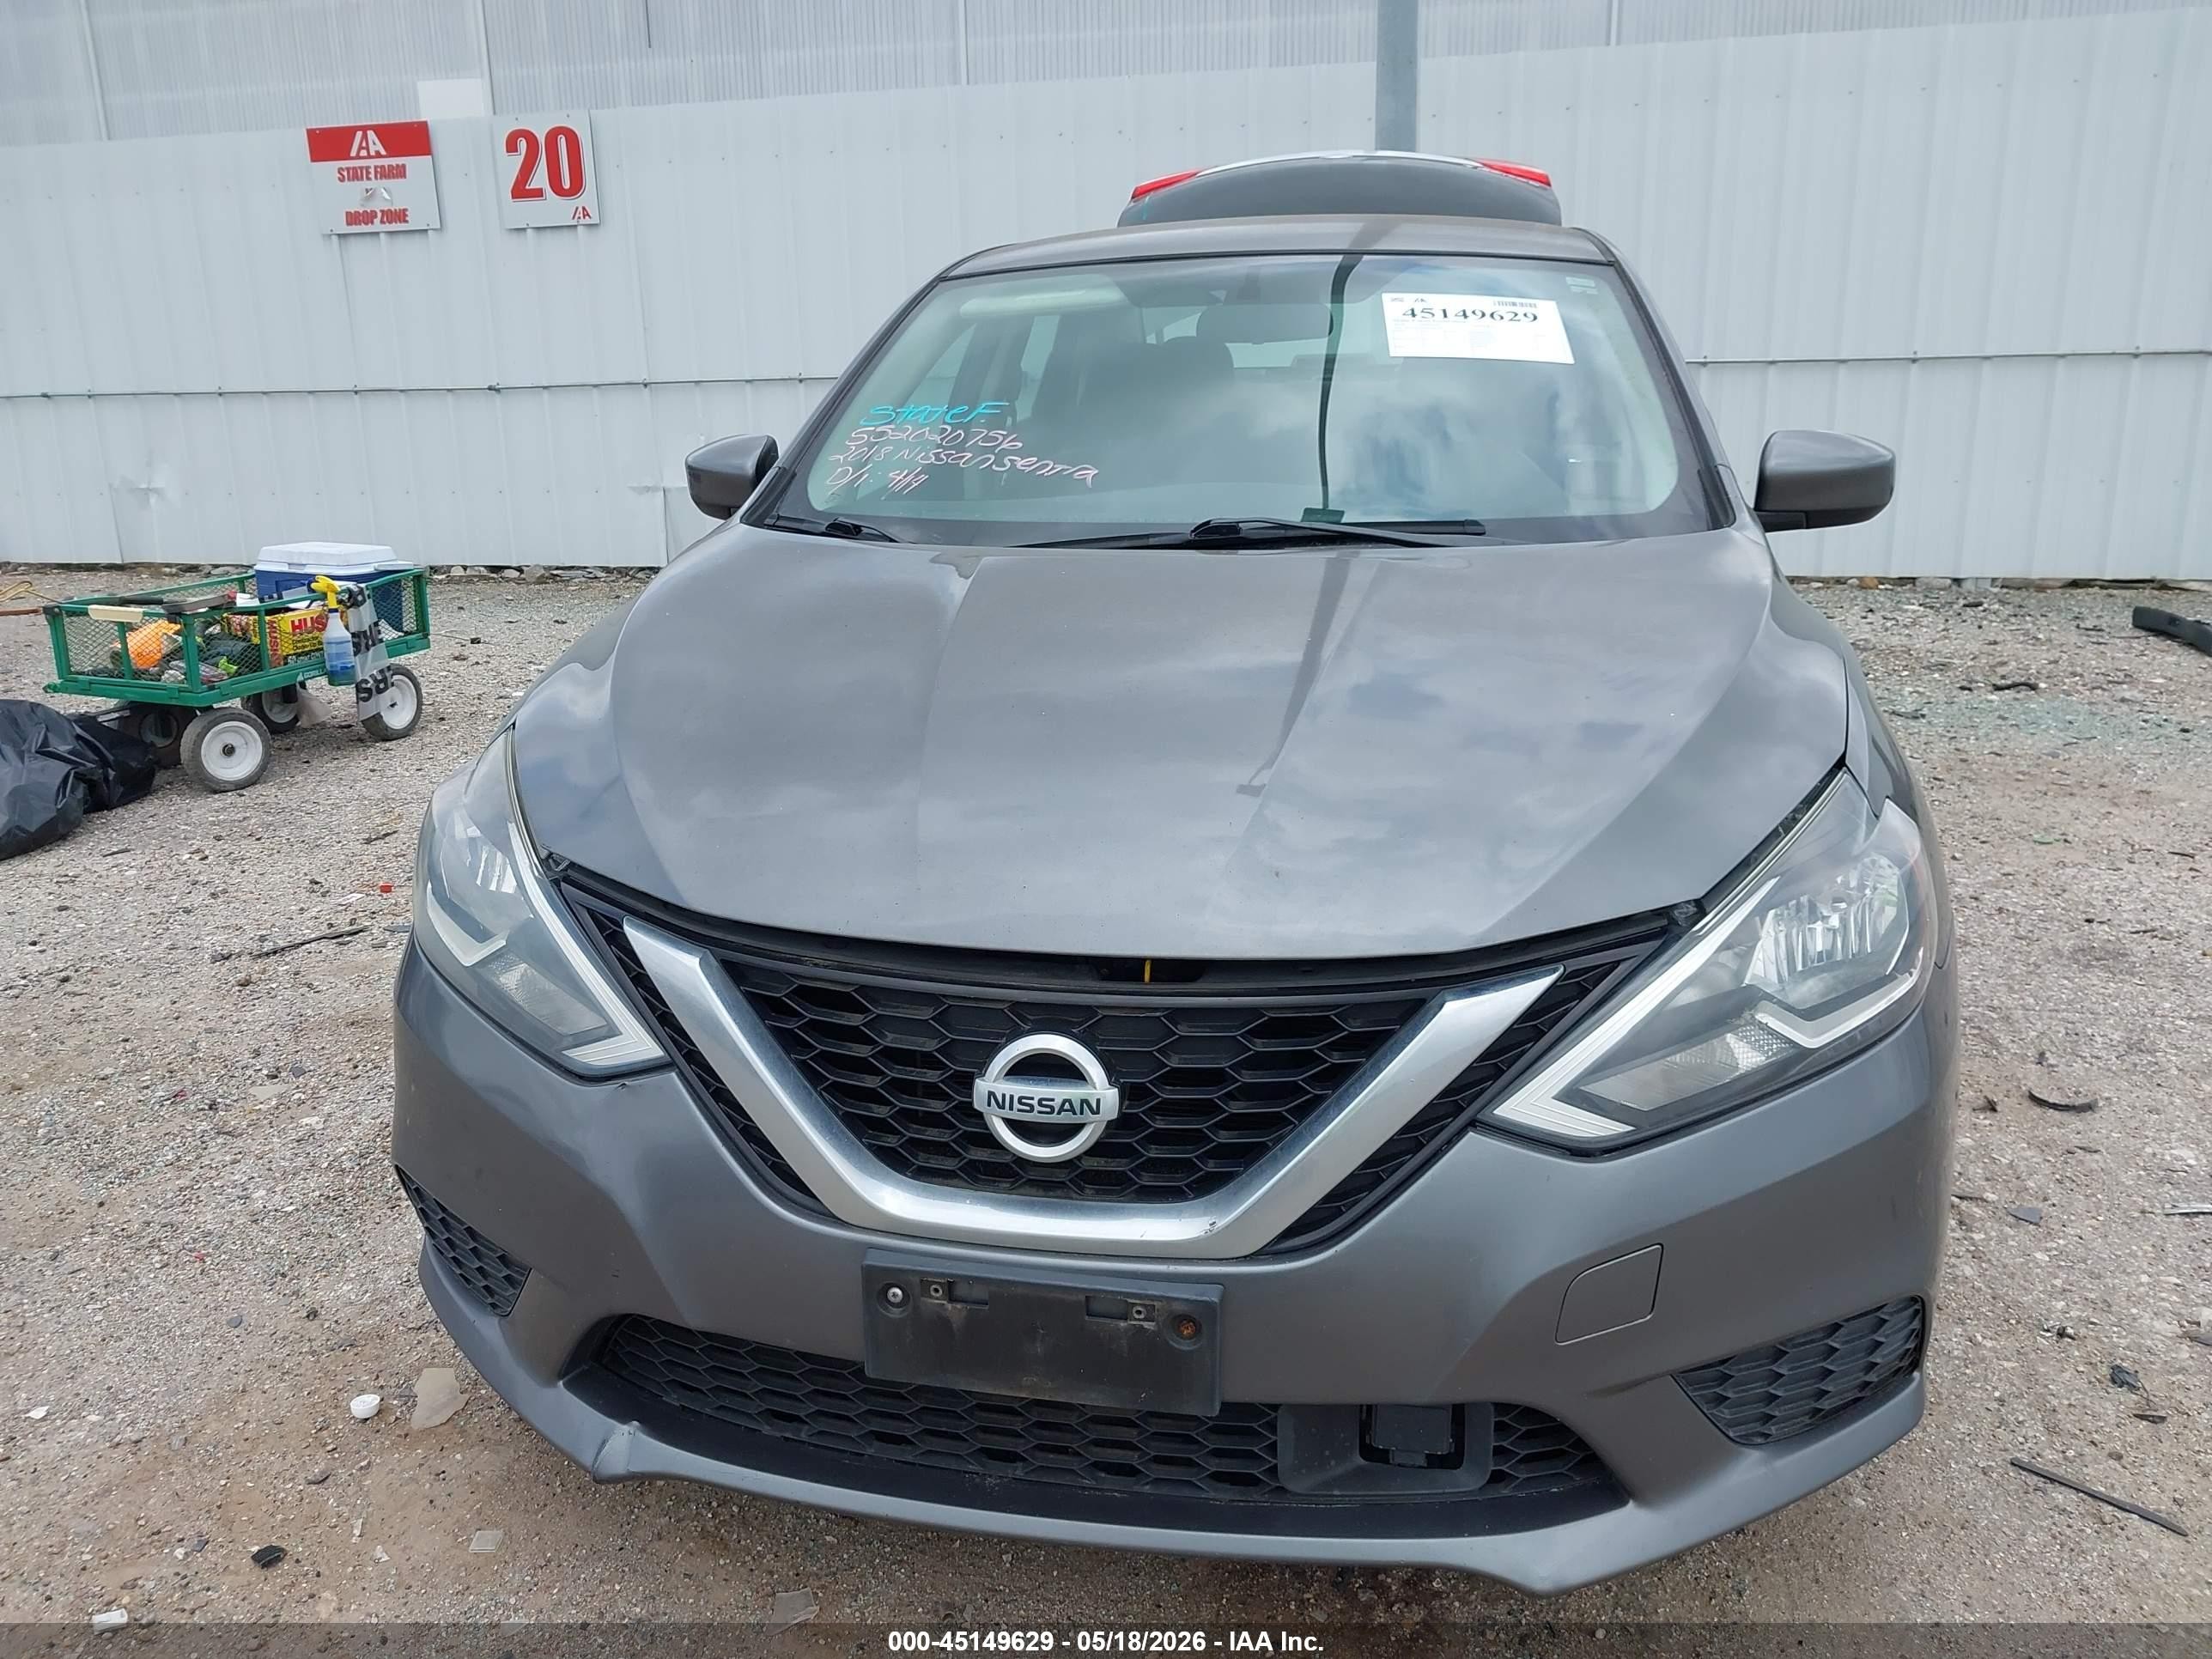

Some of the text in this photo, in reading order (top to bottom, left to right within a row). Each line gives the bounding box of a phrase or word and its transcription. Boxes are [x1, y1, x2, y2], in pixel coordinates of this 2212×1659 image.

[337, 163, 407, 183] STATE FARM
[505, 125, 586, 201] 20
[345, 208, 410, 227] DROP ZONE
[1402, 307, 1538, 322] 45149629
[845, 424, 1024, 453] 552020756
[829, 445, 893, 464] 2018
[290, 614, 326, 634] HUS
[987, 1090, 1101, 1116] NISSAN
